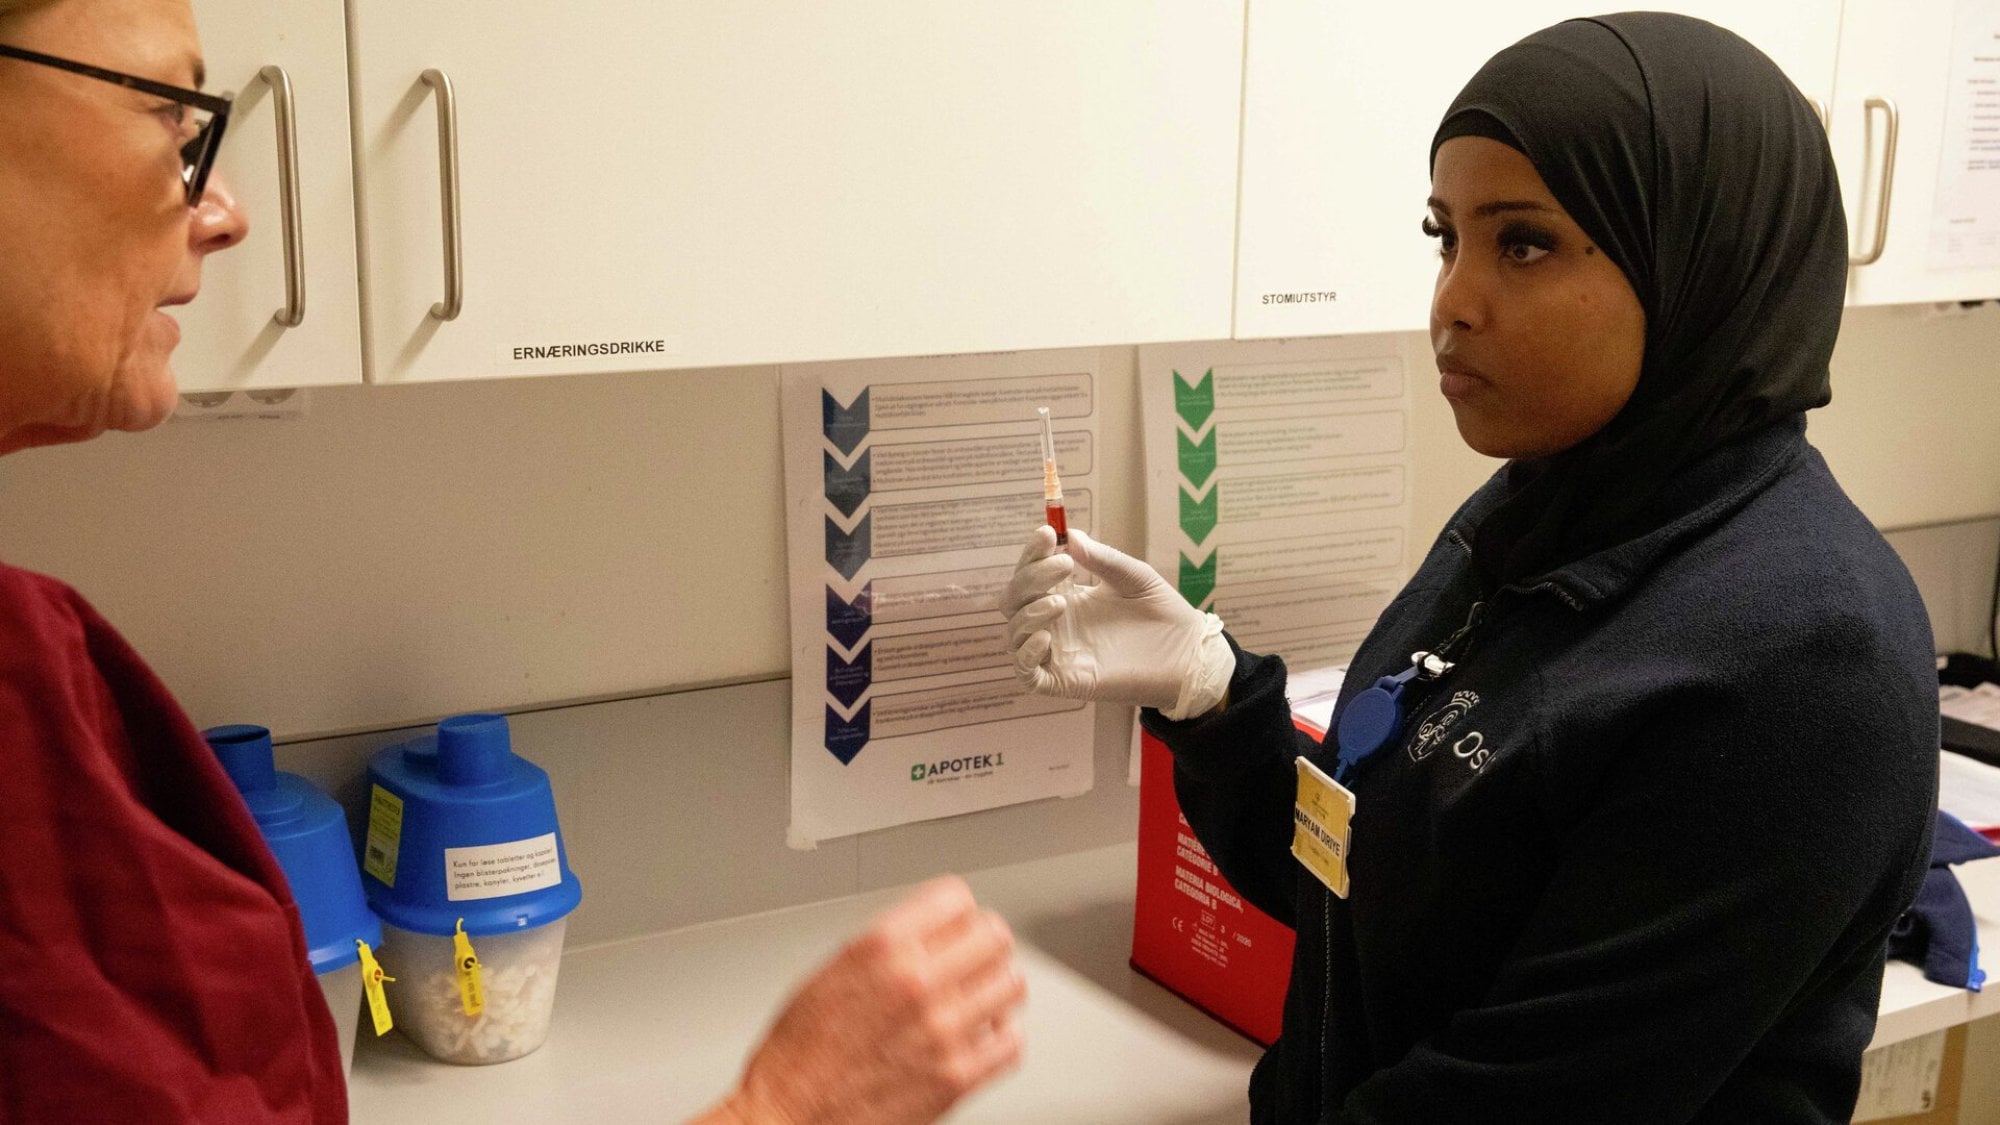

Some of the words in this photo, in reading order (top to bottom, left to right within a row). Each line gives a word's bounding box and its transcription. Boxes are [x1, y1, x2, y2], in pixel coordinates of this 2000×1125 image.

[1262, 291, 1337, 305] STOMIUTSTYR
[513, 340, 665, 359] ERNÆRINGSDRIKKE
[928, 754, 993, 777] APOTEK
[995, 752, 1005, 766] 1
[1453, 731, 1498, 775] Osl
[1295, 807, 1321, 841] MARYAM
[1320, 829, 1341, 857] DIRIYE
[497, 854, 525, 864] tabletter
[454, 870, 475, 880] Ingen
[1175, 864, 1204, 891] MATERIA
[1175, 877, 1210, 907] CATEGORIA
[1211, 898, 1218, 910] B
